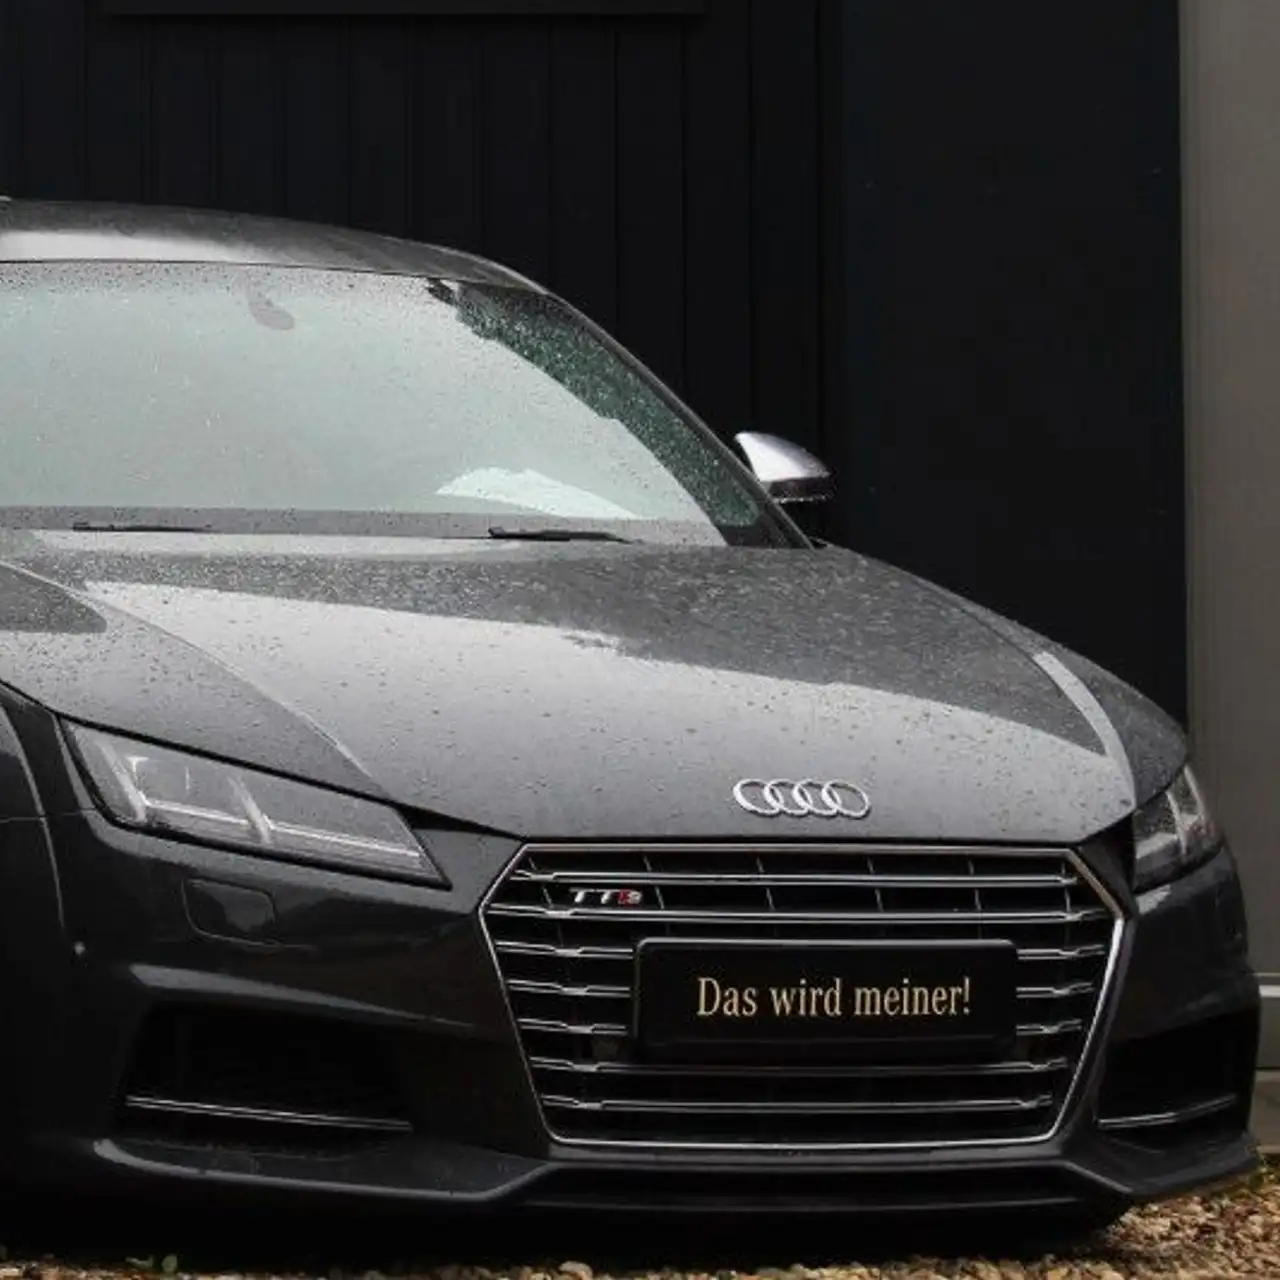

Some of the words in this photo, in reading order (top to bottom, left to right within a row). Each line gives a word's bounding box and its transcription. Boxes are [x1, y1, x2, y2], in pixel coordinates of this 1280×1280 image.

[696, 976, 759, 1017] Das
[768, 976, 843, 1017] wird
[853, 976, 971, 1016] meiner!
